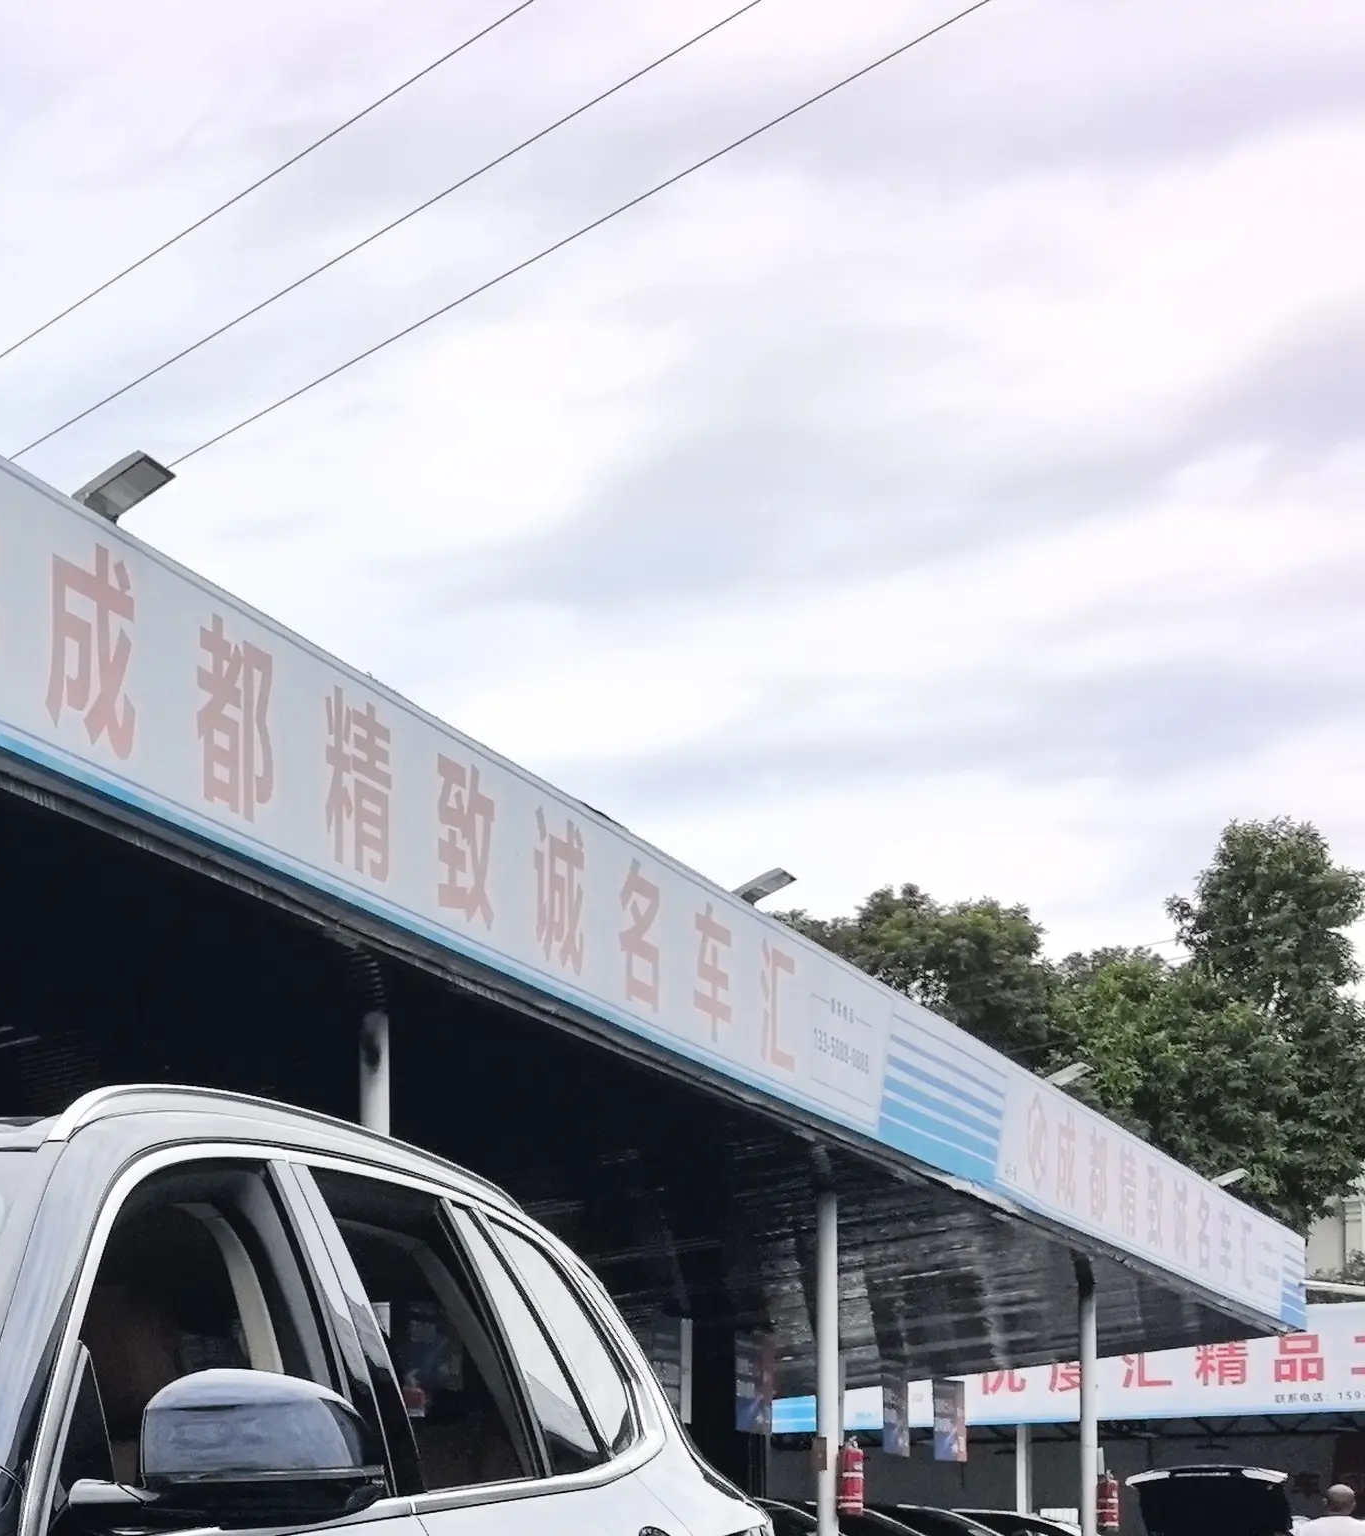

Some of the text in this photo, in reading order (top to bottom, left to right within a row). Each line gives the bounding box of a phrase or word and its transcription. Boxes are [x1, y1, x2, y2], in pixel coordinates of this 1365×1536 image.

[46, 544, 797, 1074] 成都精致诚名车汇
